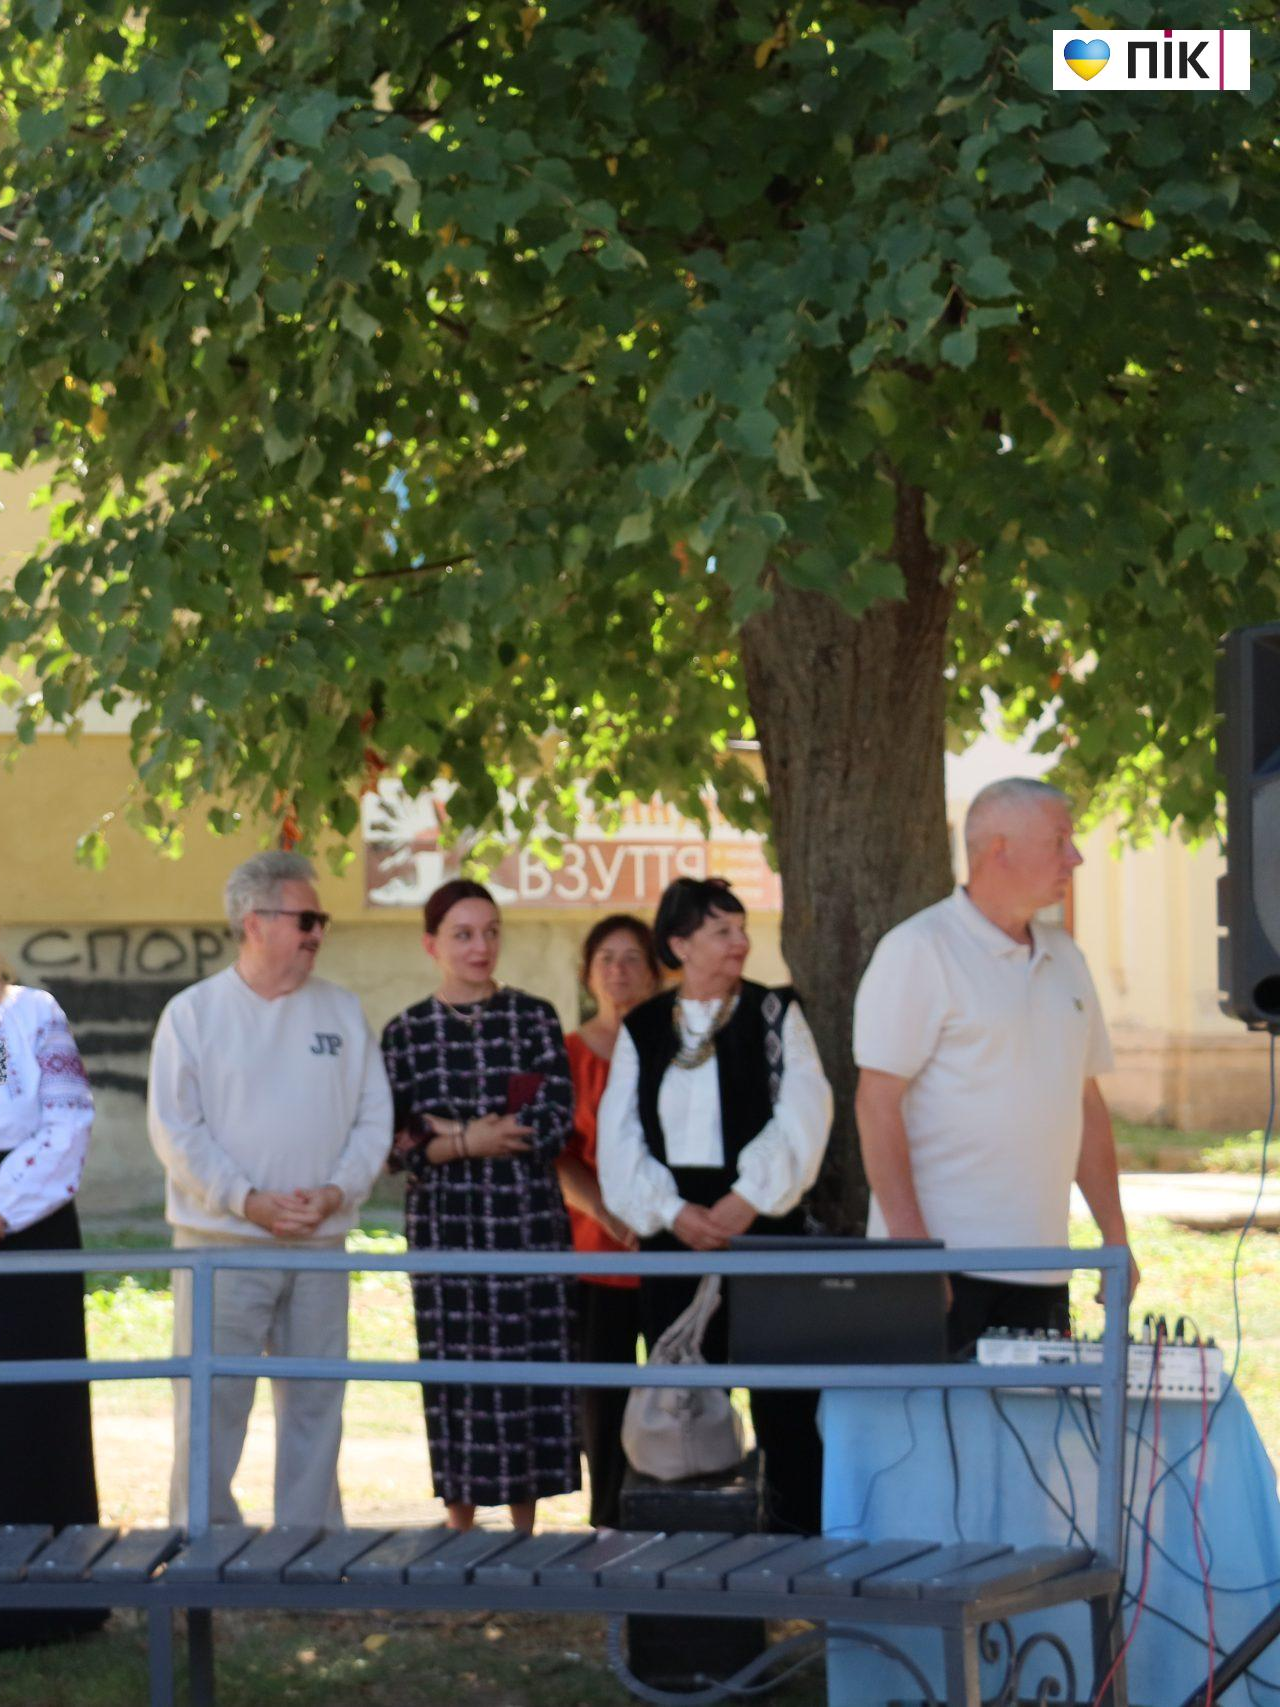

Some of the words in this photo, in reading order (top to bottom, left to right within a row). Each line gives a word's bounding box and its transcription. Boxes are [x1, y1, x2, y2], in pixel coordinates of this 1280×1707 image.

[520, 843, 706, 900] ВЗУТТЯ
[22, 928, 232, 977] СПОР
[310, 1033, 343, 1056] JP
